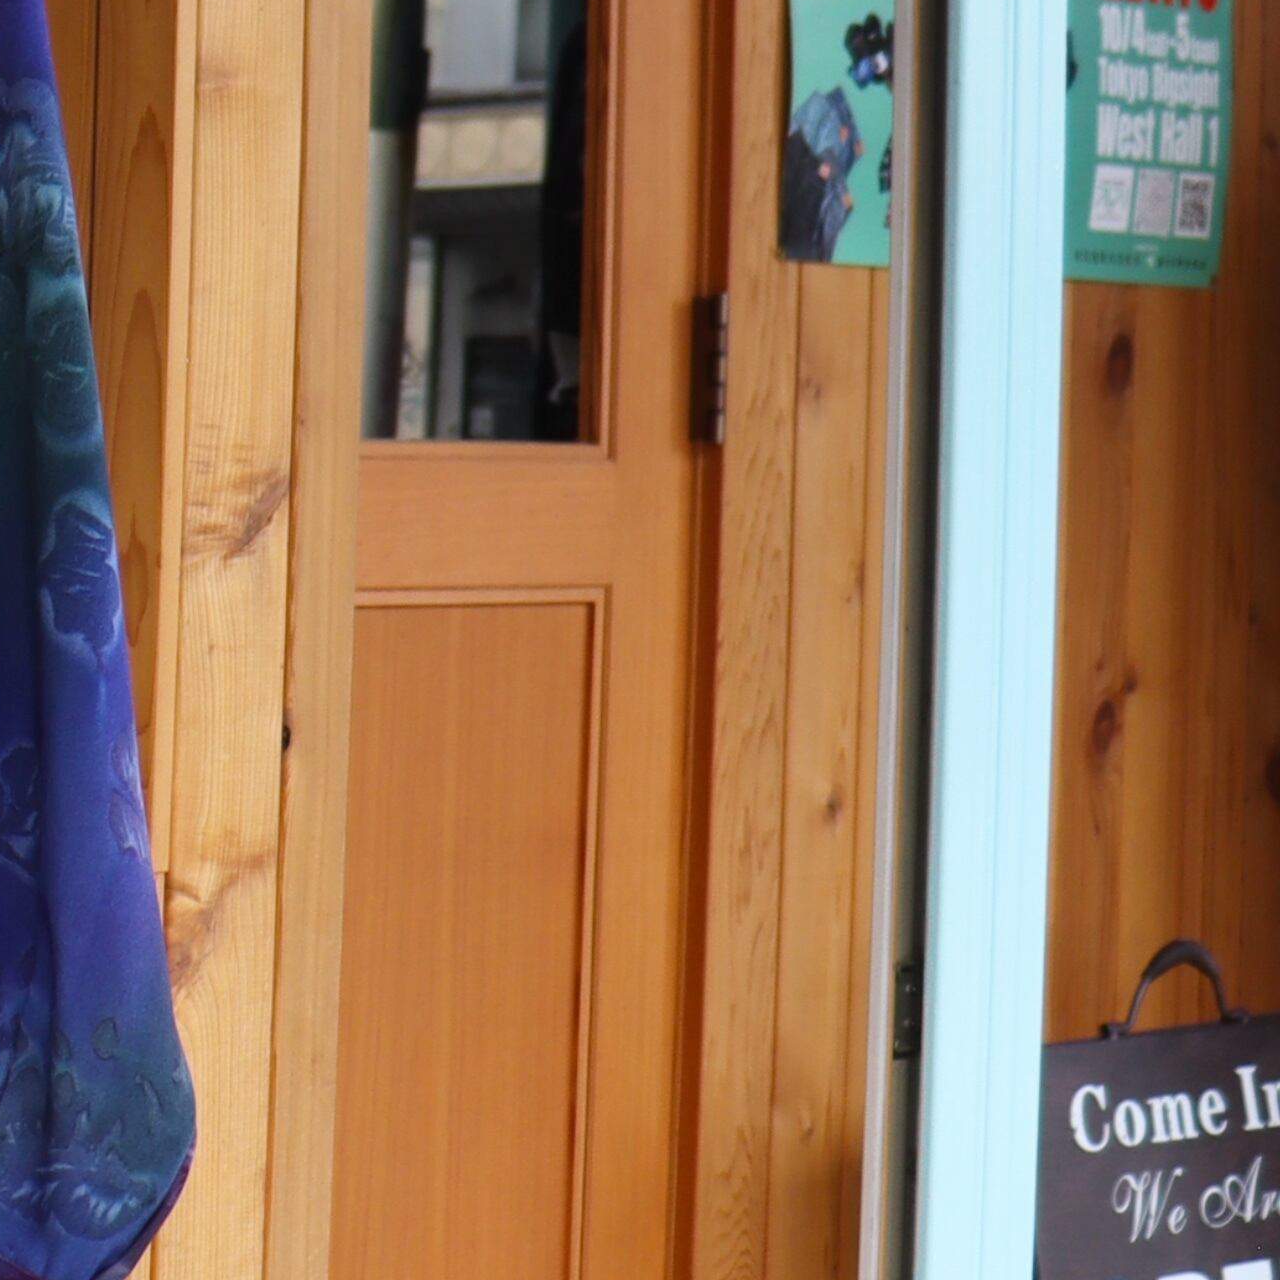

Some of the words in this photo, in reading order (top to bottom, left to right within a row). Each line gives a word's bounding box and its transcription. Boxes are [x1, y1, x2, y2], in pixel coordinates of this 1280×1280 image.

[1098, 55, 1149, 104] Tokyo
[1097, 102, 1156, 161] West
[1159, 110, 1204, 166] Hall
[1208, 114, 1220, 168] 1
[1070, 1083, 1229, 1153] Come
[1113, 1166, 1188, 1244] We
[1200, 1155, 1280, 1228] Ar
